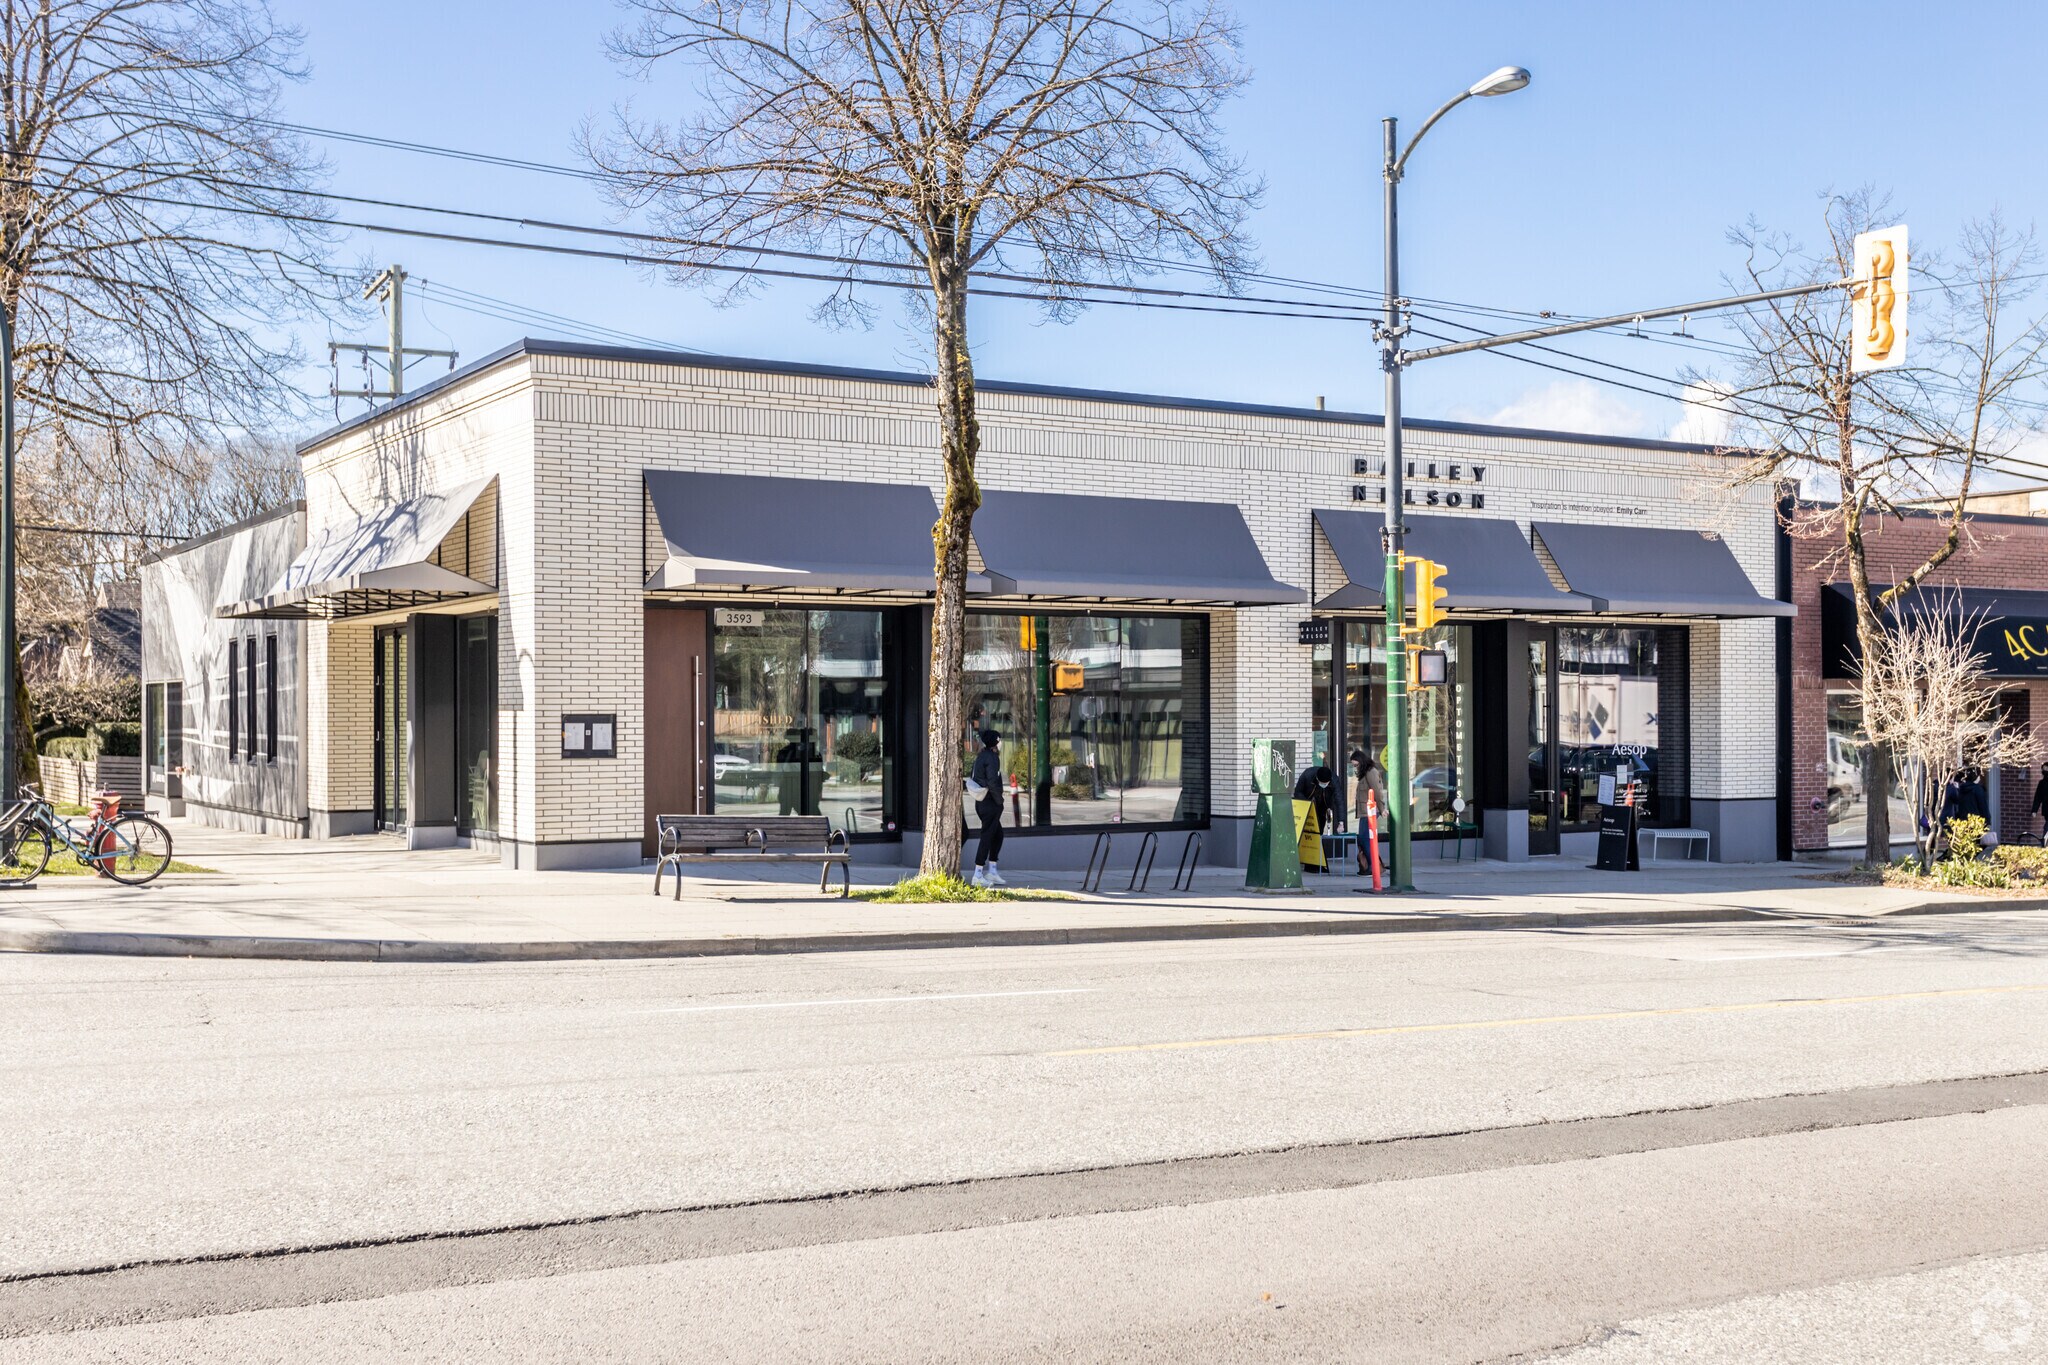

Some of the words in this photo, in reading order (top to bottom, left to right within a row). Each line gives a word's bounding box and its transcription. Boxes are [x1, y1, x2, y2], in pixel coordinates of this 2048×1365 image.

[1354, 459, 1485, 481] BILEY
[1617, 507, 1632, 515] Emily
[726, 614, 752, 623] 3593
[1612, 743, 1647, 759] Aesop
